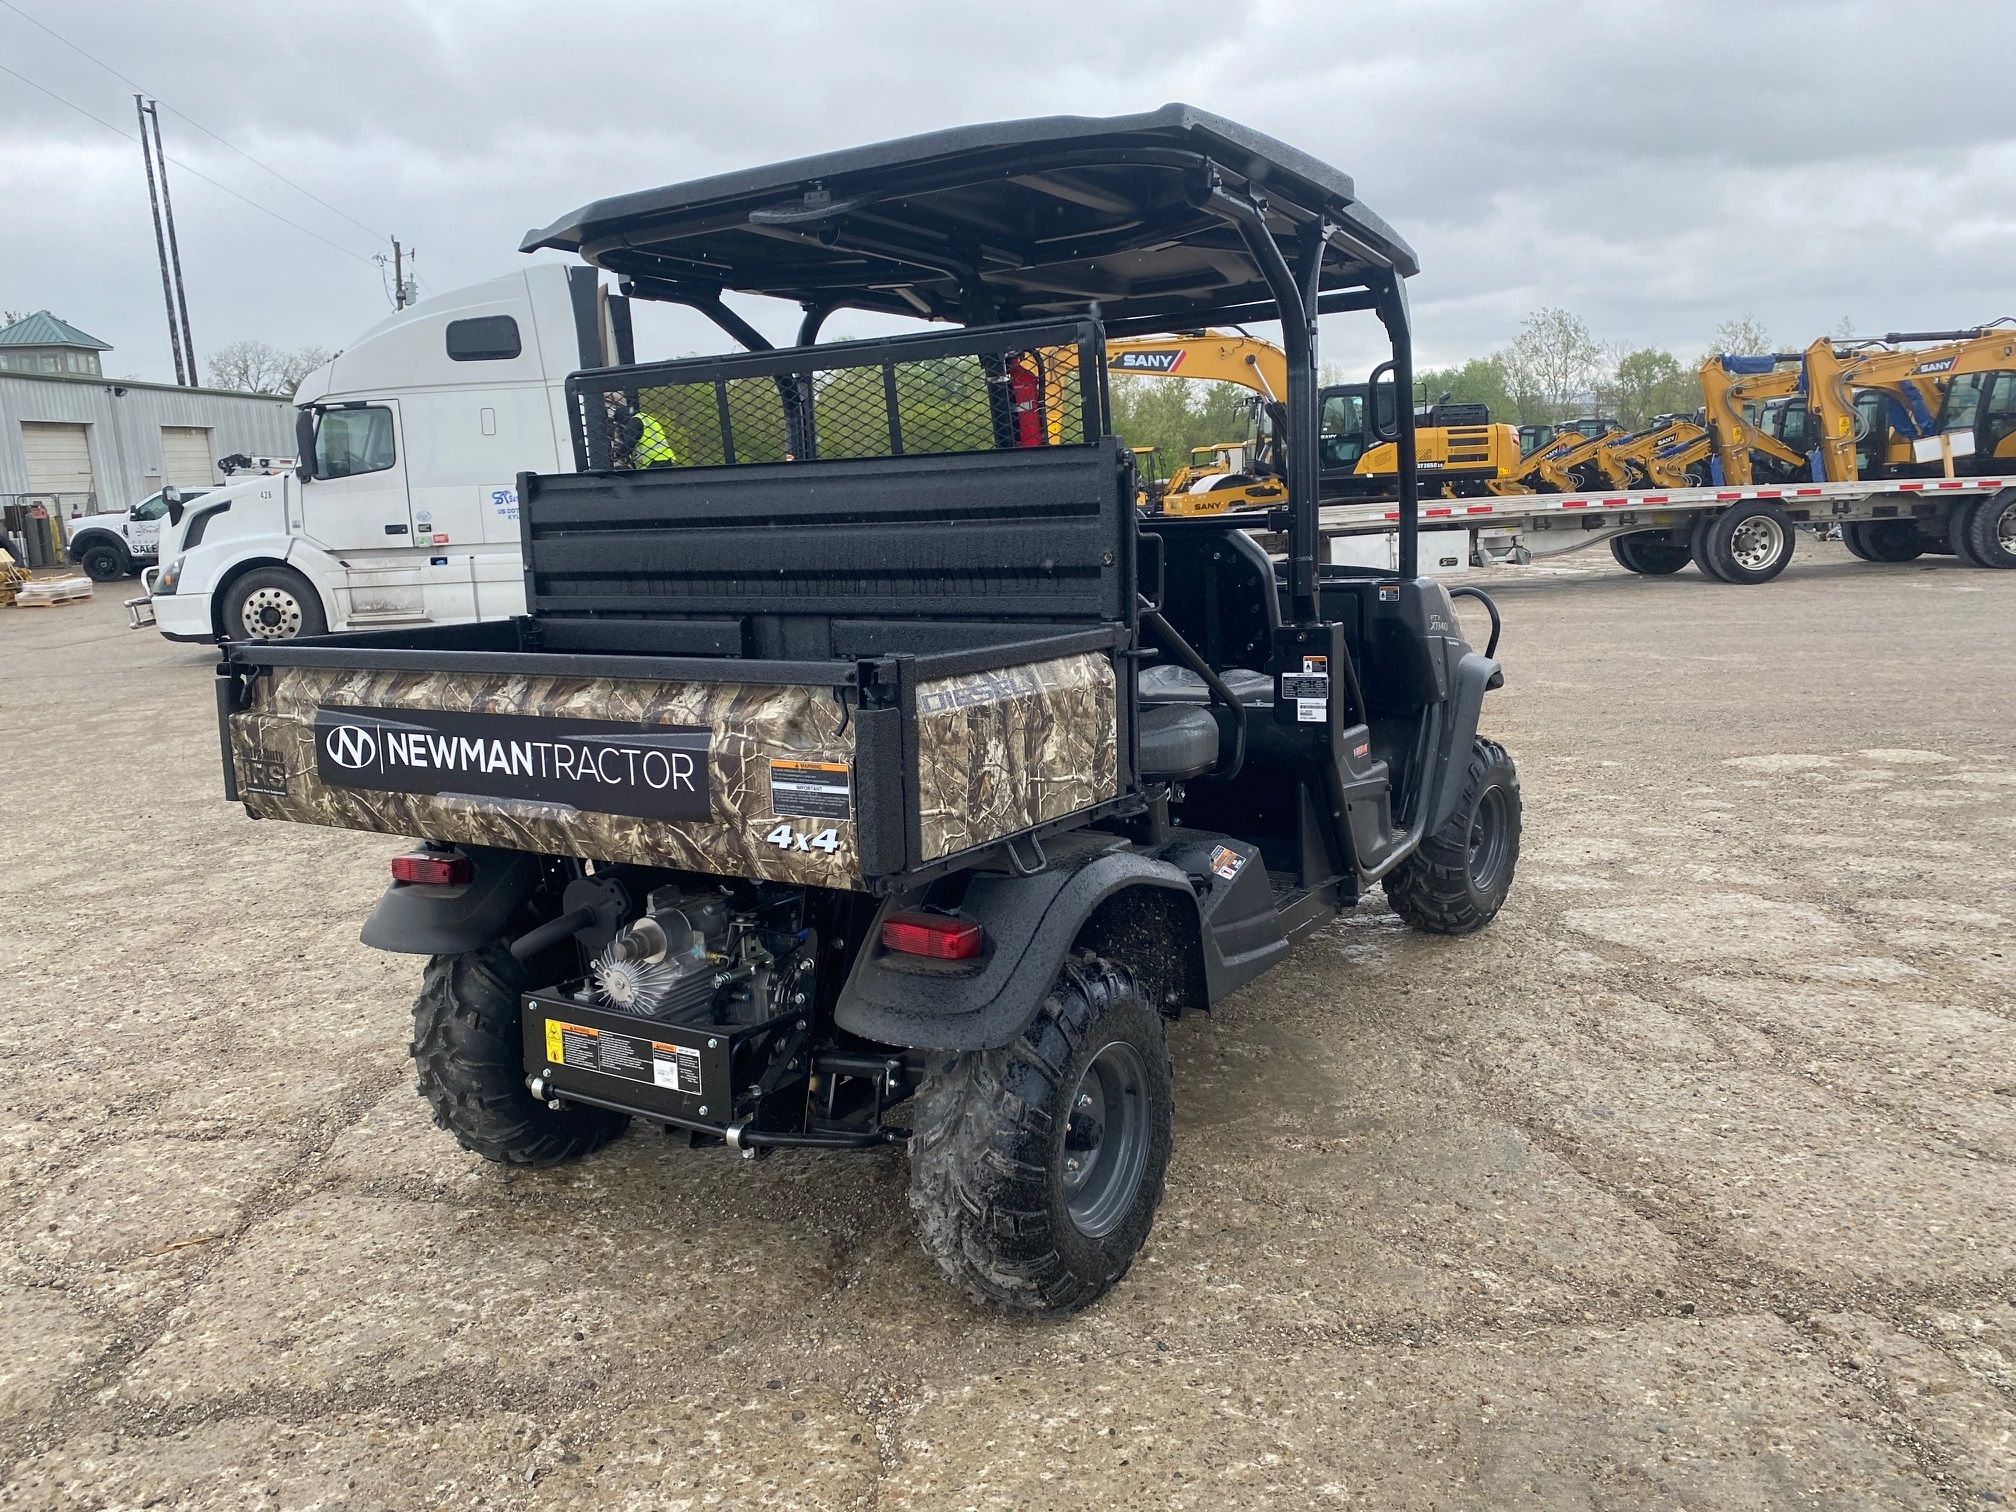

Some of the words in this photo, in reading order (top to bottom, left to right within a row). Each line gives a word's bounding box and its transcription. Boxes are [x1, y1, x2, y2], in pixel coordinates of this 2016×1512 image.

[1123, 354, 1173, 367] SANY
[1920, 360, 1952, 373] SANY
[1657, 435, 1675, 446] SANY
[1194, 502, 1221, 511] SANY
[766, 824, 839, 854] 4x4
